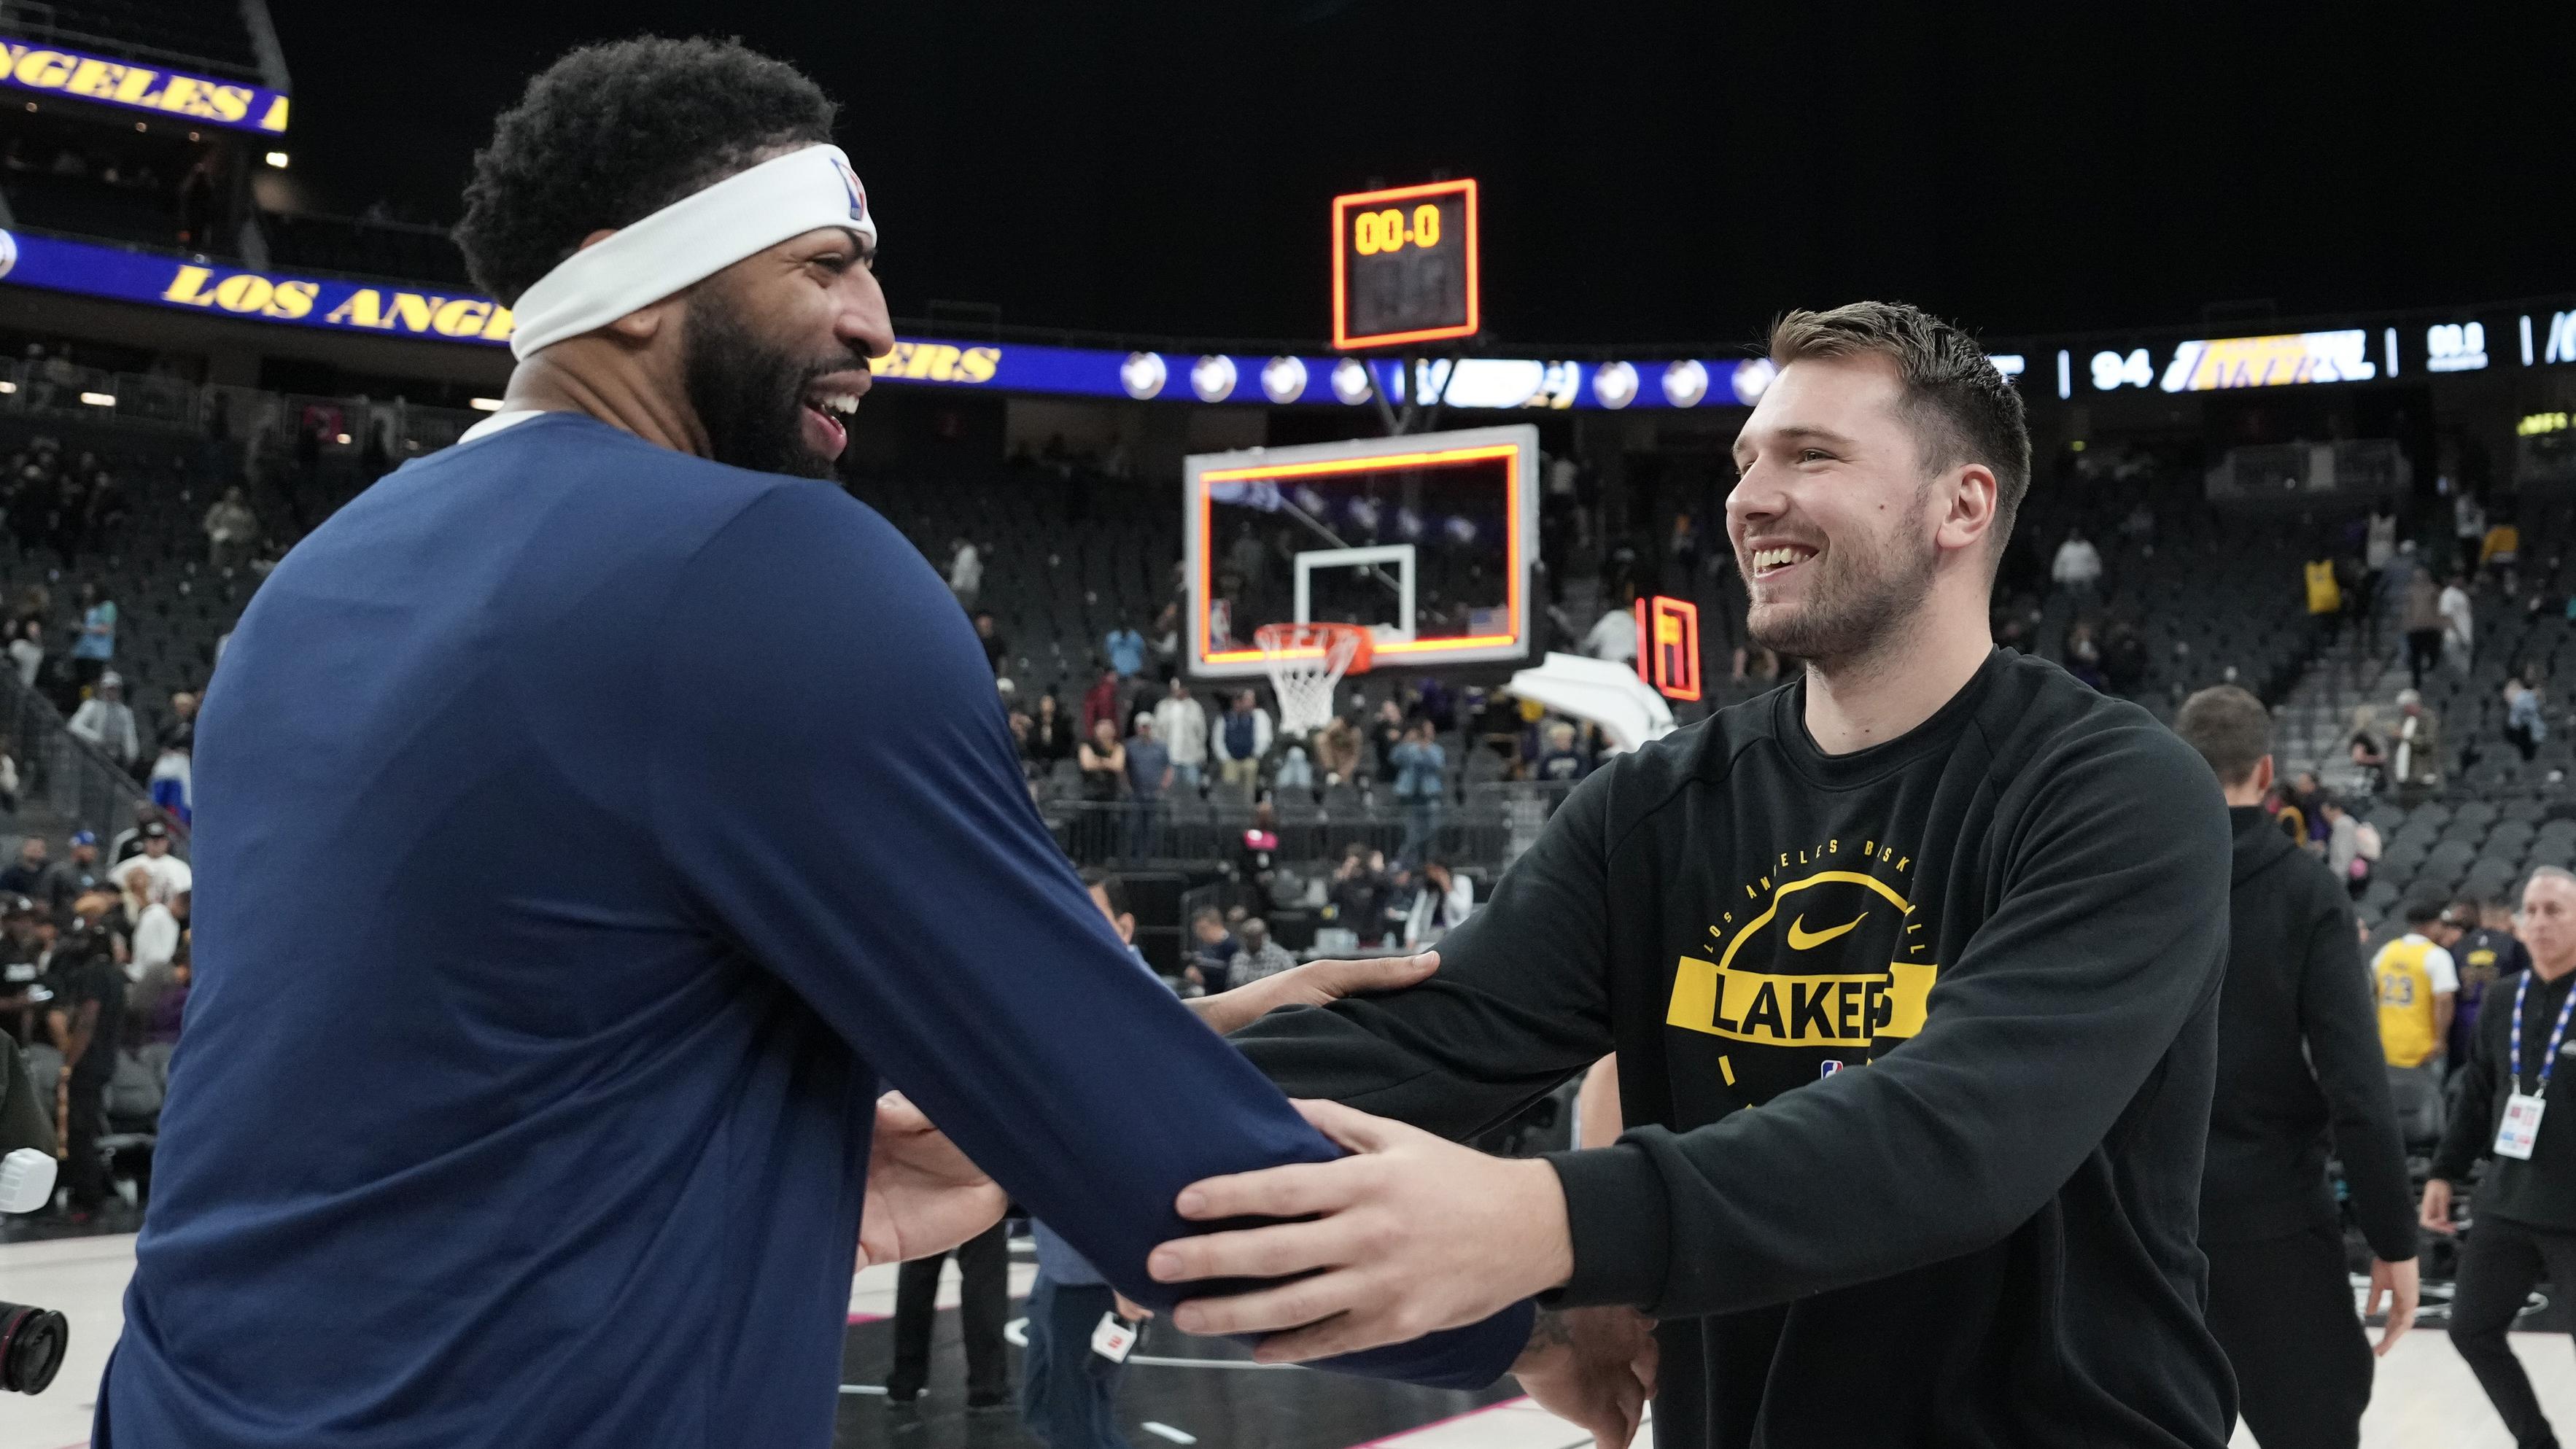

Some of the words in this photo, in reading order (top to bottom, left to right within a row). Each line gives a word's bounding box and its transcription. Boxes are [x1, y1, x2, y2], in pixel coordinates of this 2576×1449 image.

[162, 265, 319, 319] LOS
[2091, 349, 2154, 391] 94
[1704, 912, 1732, 953] LOS
[1745, 839, 1838, 899] ANELES
